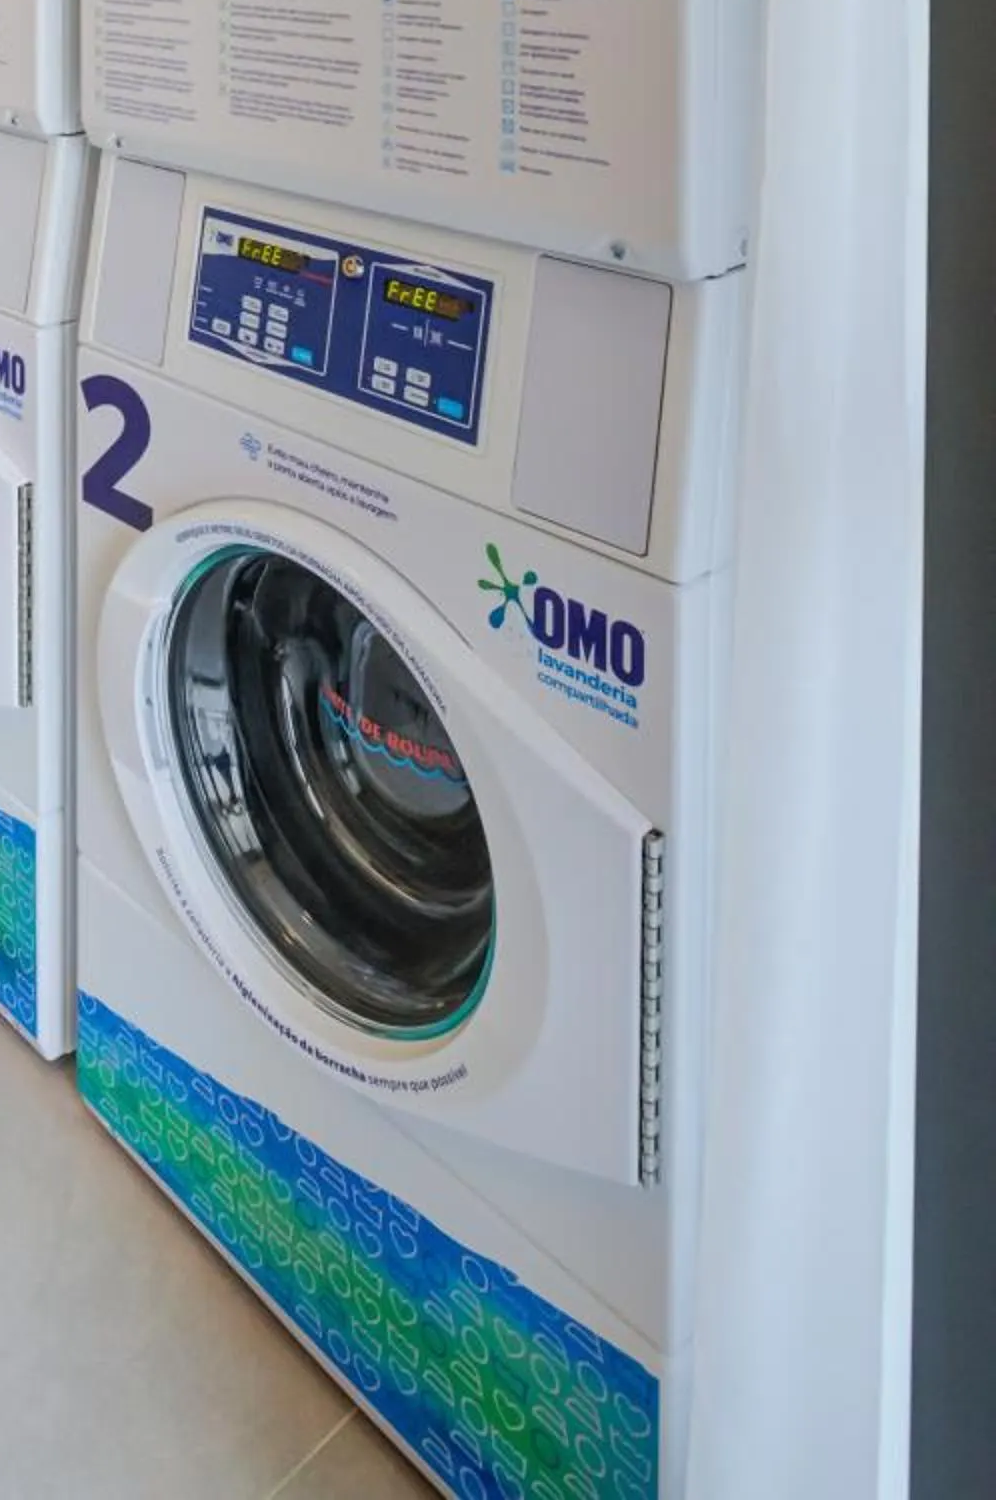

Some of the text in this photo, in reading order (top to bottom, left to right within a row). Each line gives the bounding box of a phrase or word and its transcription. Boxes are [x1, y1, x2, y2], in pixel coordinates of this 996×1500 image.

[80, 374, 154, 533] 2
[531, 586, 645, 688] OMO
[537, 670, 639, 730] compartilhada
[538, 647, 638, 710] lavanderia
[315, 1046, 366, 1083] borracha
[367, 1075, 408, 1092] sempre
[409, 1080, 429, 1093] que
